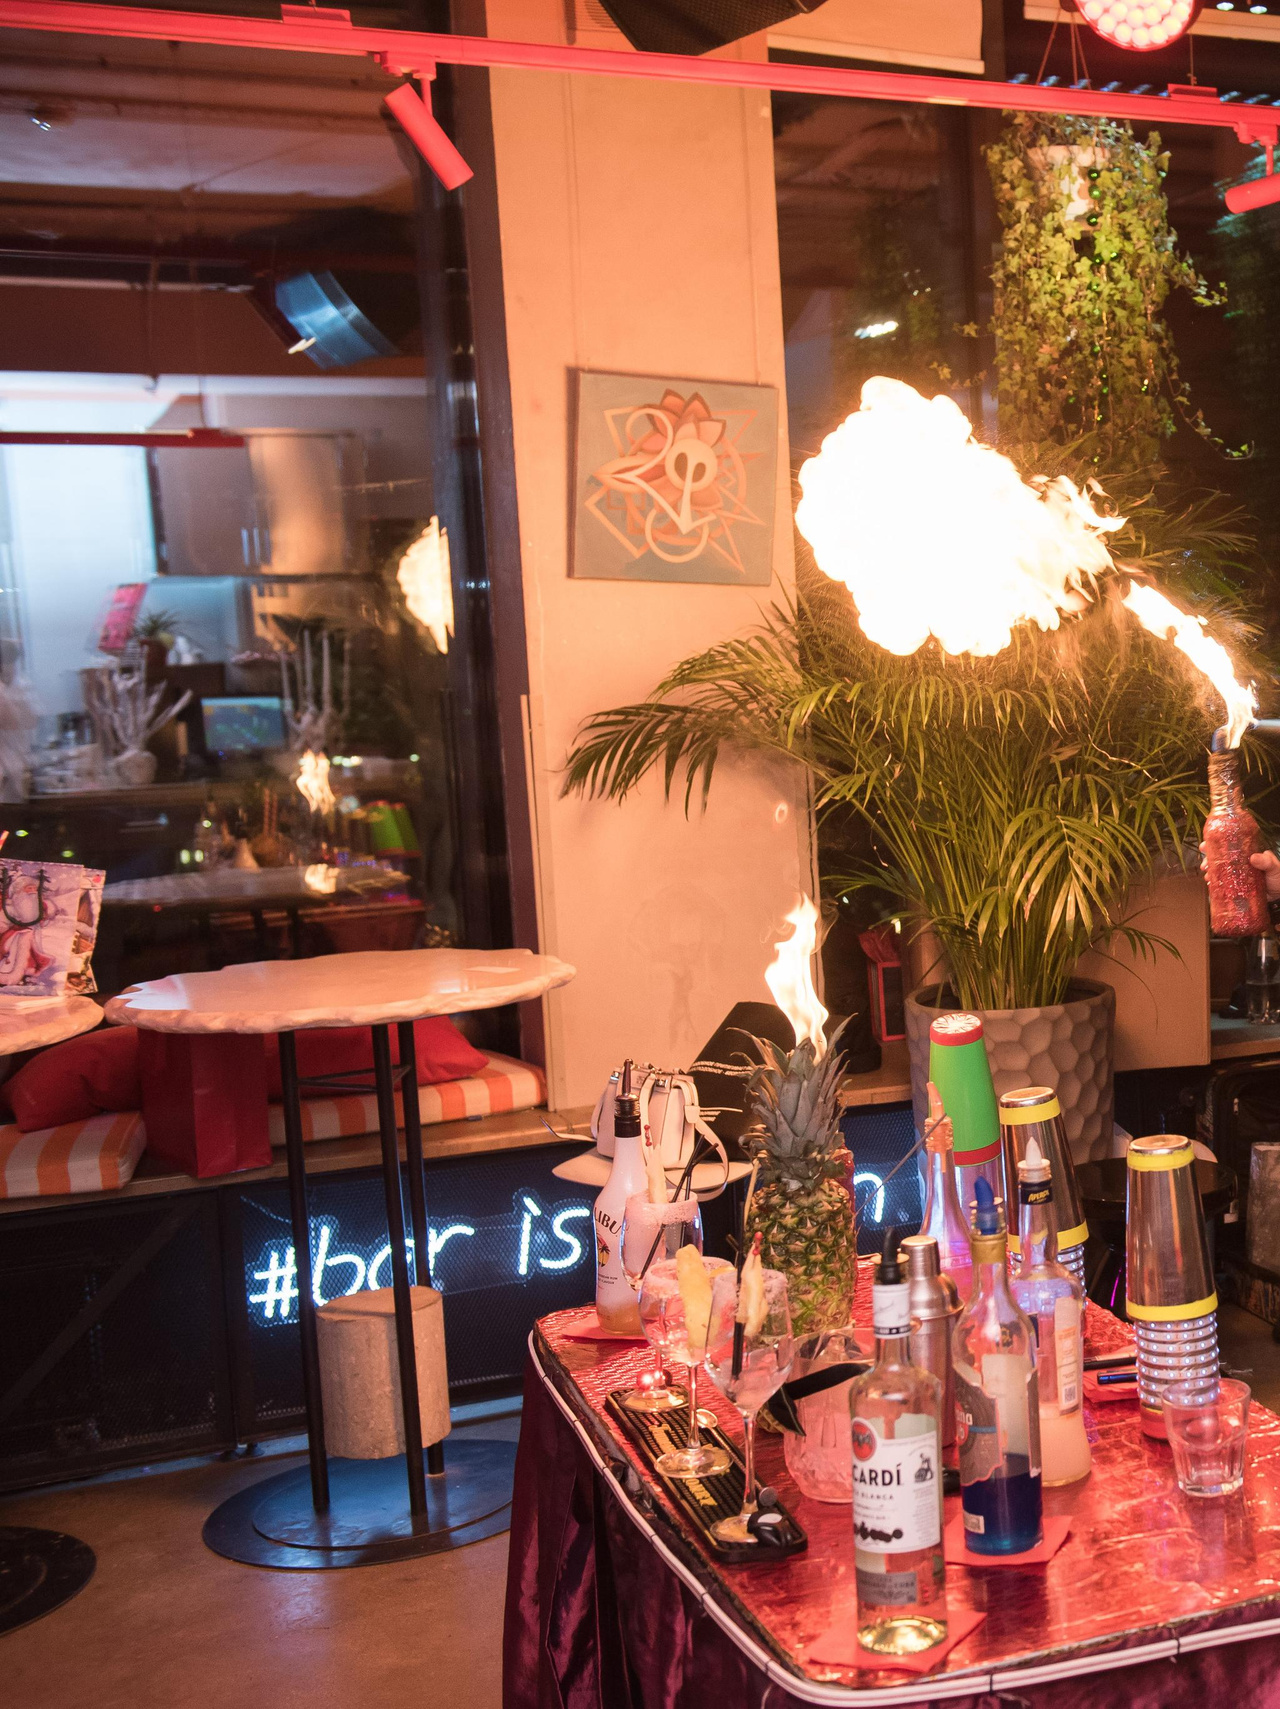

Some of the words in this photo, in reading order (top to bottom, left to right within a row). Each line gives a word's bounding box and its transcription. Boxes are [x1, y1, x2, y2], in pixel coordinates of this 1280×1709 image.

[594, 1206, 622, 1235] LIBU
[518, 1196, 591, 1276] is
[852, 1462, 903, 1487] CARDÍ
